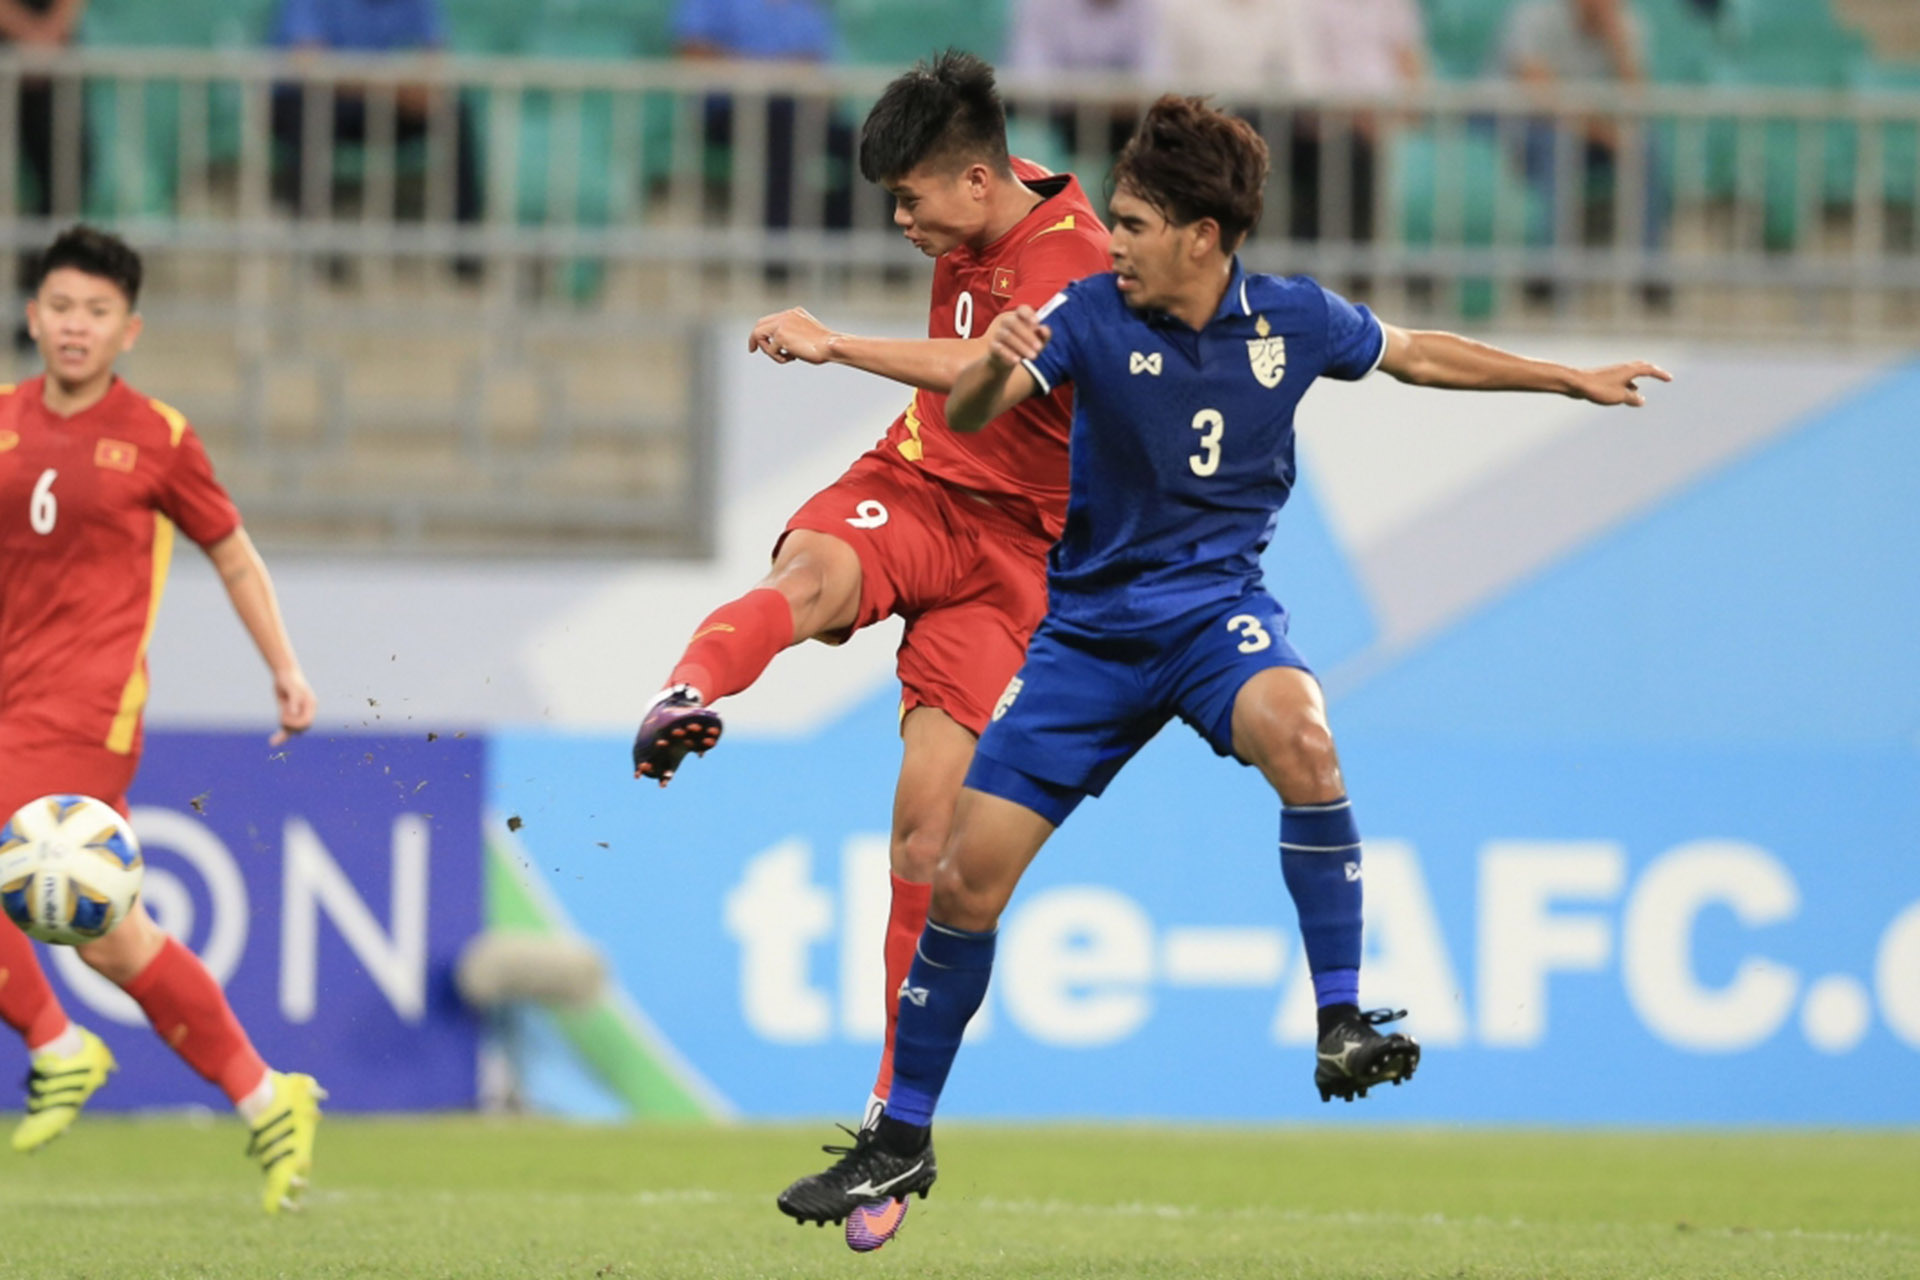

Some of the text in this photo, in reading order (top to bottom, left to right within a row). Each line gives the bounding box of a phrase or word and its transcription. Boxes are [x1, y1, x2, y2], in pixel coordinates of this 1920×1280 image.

[954, 290, 974, 340] 9
[1188, 408, 1225, 477] 3
[29, 467, 59, 536] 6
[845, 499, 889, 530] 9
[1226, 613, 1272, 654] 3
[722, 832, 1920, 1054] te-AFC.
